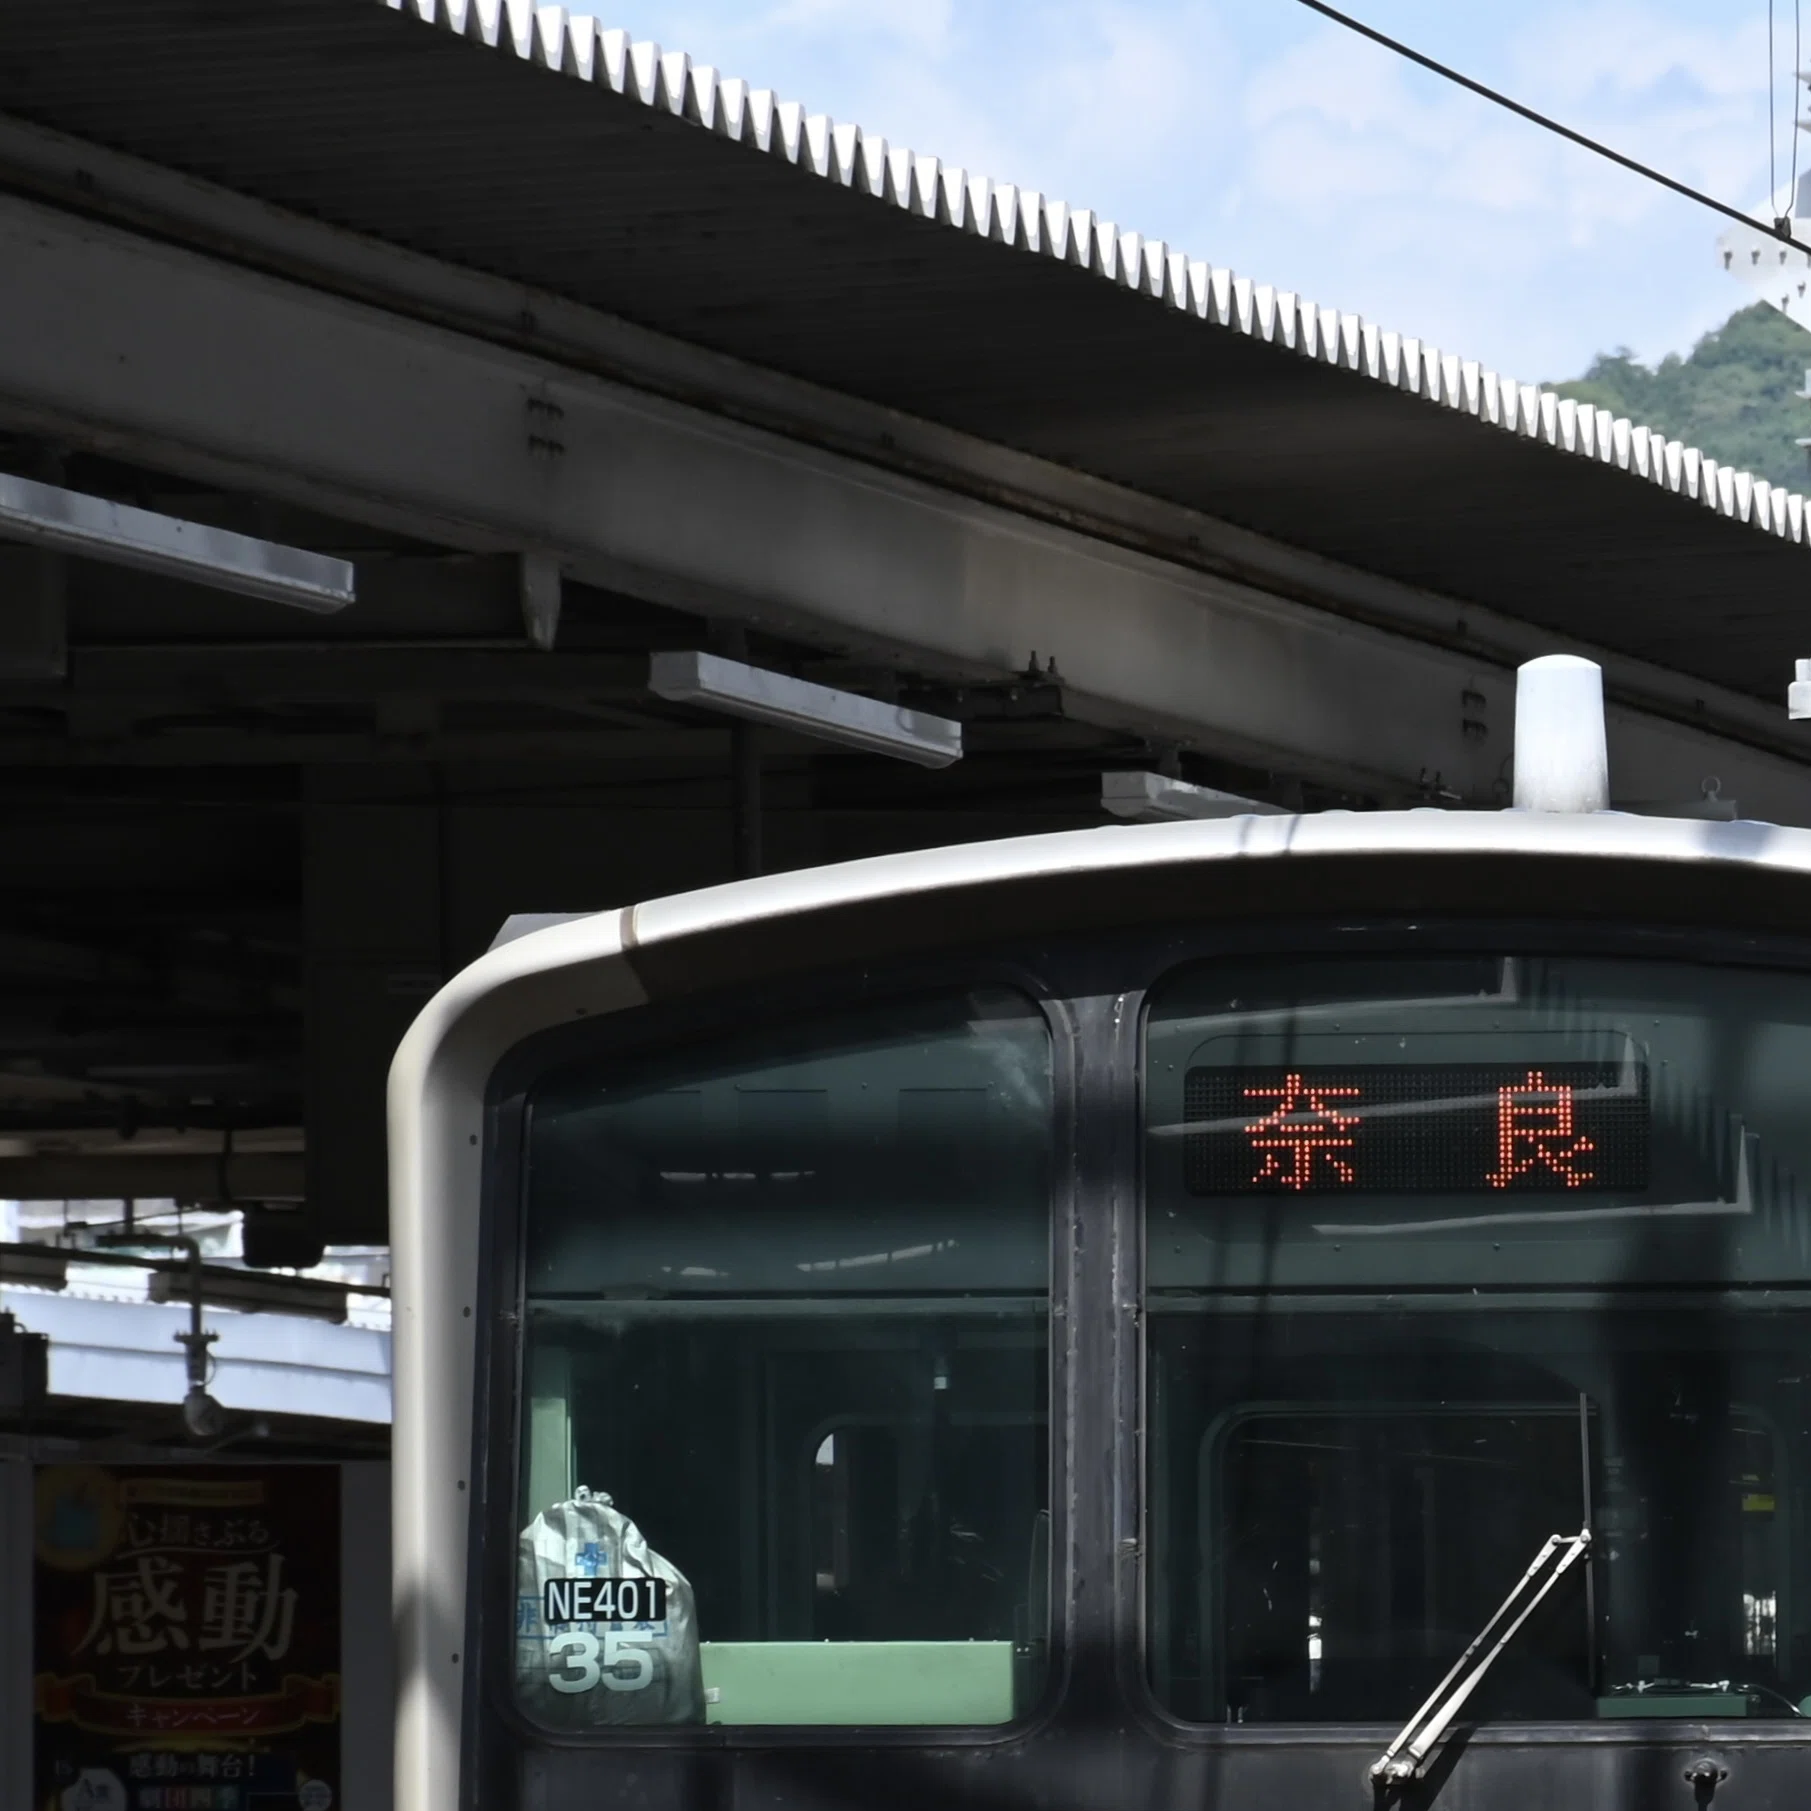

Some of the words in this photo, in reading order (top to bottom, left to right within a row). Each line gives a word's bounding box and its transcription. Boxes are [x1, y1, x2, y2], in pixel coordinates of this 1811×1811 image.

[1243, 1070, 1594, 1189] 奈良
[70, 1552, 300, 1665] 感動
[548, 1580, 657, 1620] NE401
[118, 1663, 258, 1692] プレゼント
[549, 1630, 654, 1694] 35
[126, 1702, 262, 1730] キャンペーン
